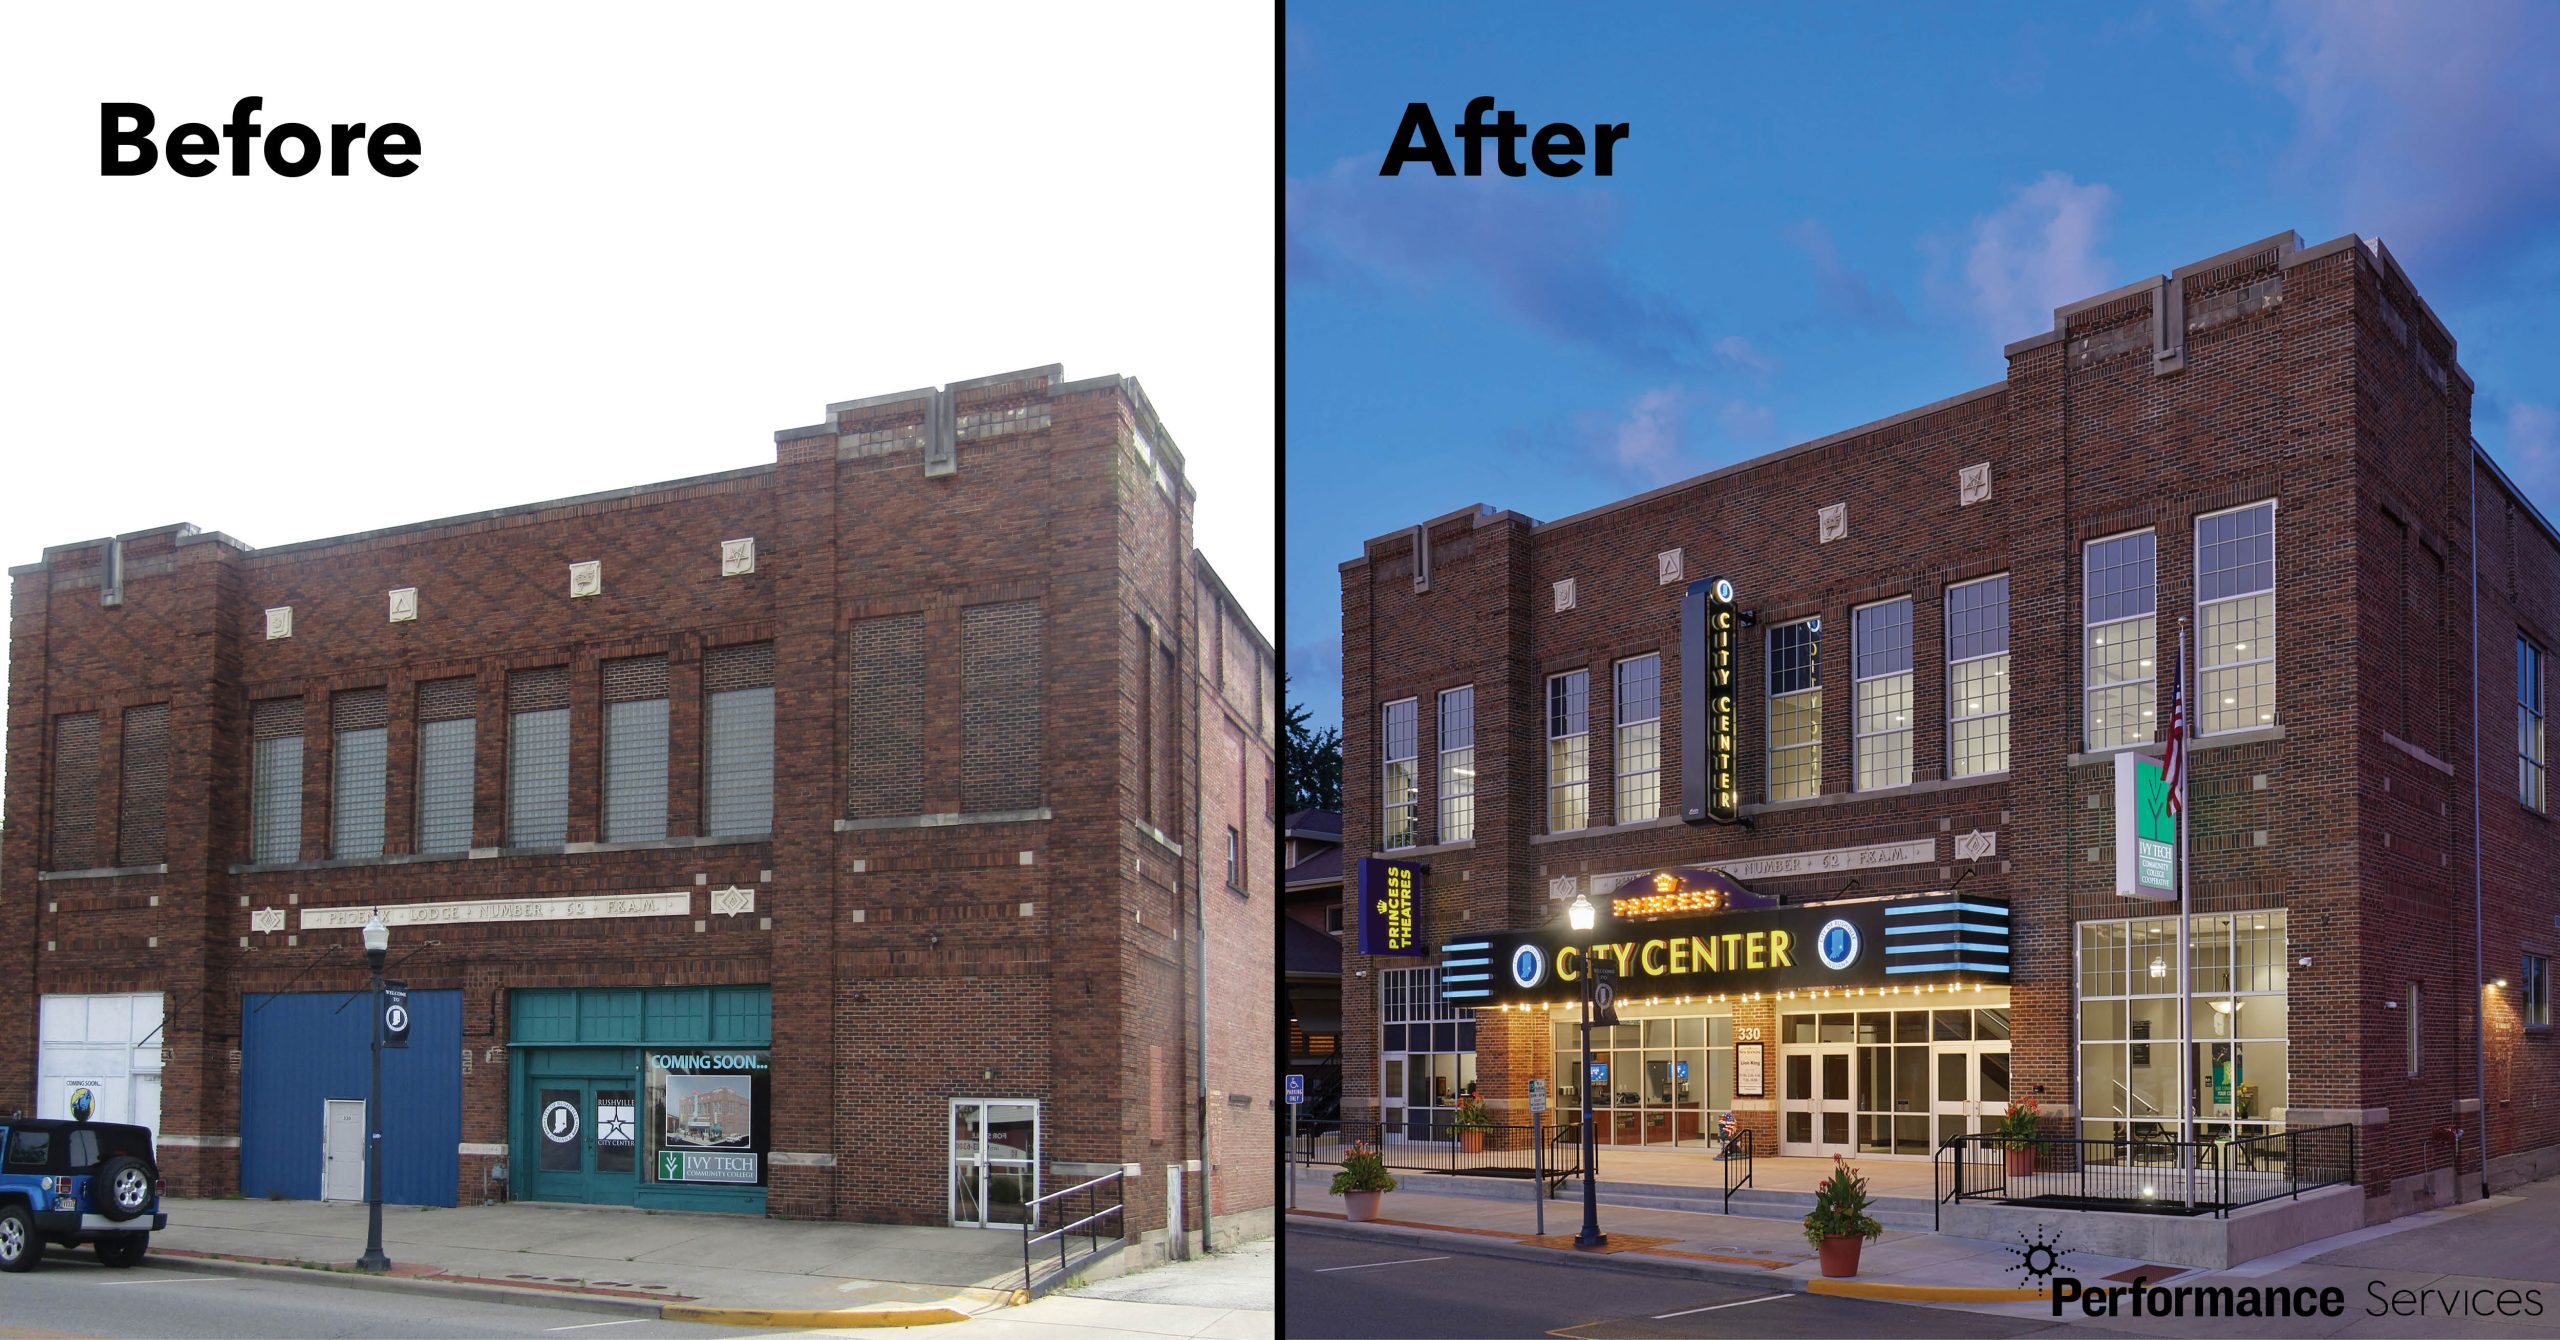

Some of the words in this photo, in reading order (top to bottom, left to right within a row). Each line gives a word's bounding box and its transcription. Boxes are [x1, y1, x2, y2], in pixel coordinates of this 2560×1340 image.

[1715, 612, 1731, 687] CITY
[1715, 696, 1731, 809] CENTER
[2139, 841, 2152, 855] IVY
[2153, 844, 2172, 860] TECH
[1745, 859, 1802, 875] NUMBER
[1823, 855, 1840, 868] 62
[2142, 859, 2169, 871] COMMUNITY
[2146, 868, 2166, 879] COLLEGE
[1388, 866, 1400, 949] PRINCESS
[1400, 869, 1412, 948] THEATRES
[1613, 889, 1719, 917] PRINCESS
[329, 909, 391, 925] PHOENX
[410, 906, 460, 921] LODGE
[479, 903, 544, 918] NUMBER
[566, 902, 586, 916] 62
[1556, 942, 1633, 982] CTY
[1641, 930, 1792, 976] CENTER
[385, 989, 407, 998] WELCOME
[1738, 1027, 1760, 1040] 330
[651, 1054, 711, 1069] COMING
[713, 1055, 768, 1069] SOON...
[687, 1156, 712, 1170] IVY
[714, 1157, 753, 1171] TECH
[686, 1169, 728, 1178] COMMUNITY
[729, 1170, 754, 1178] COLLEGE
